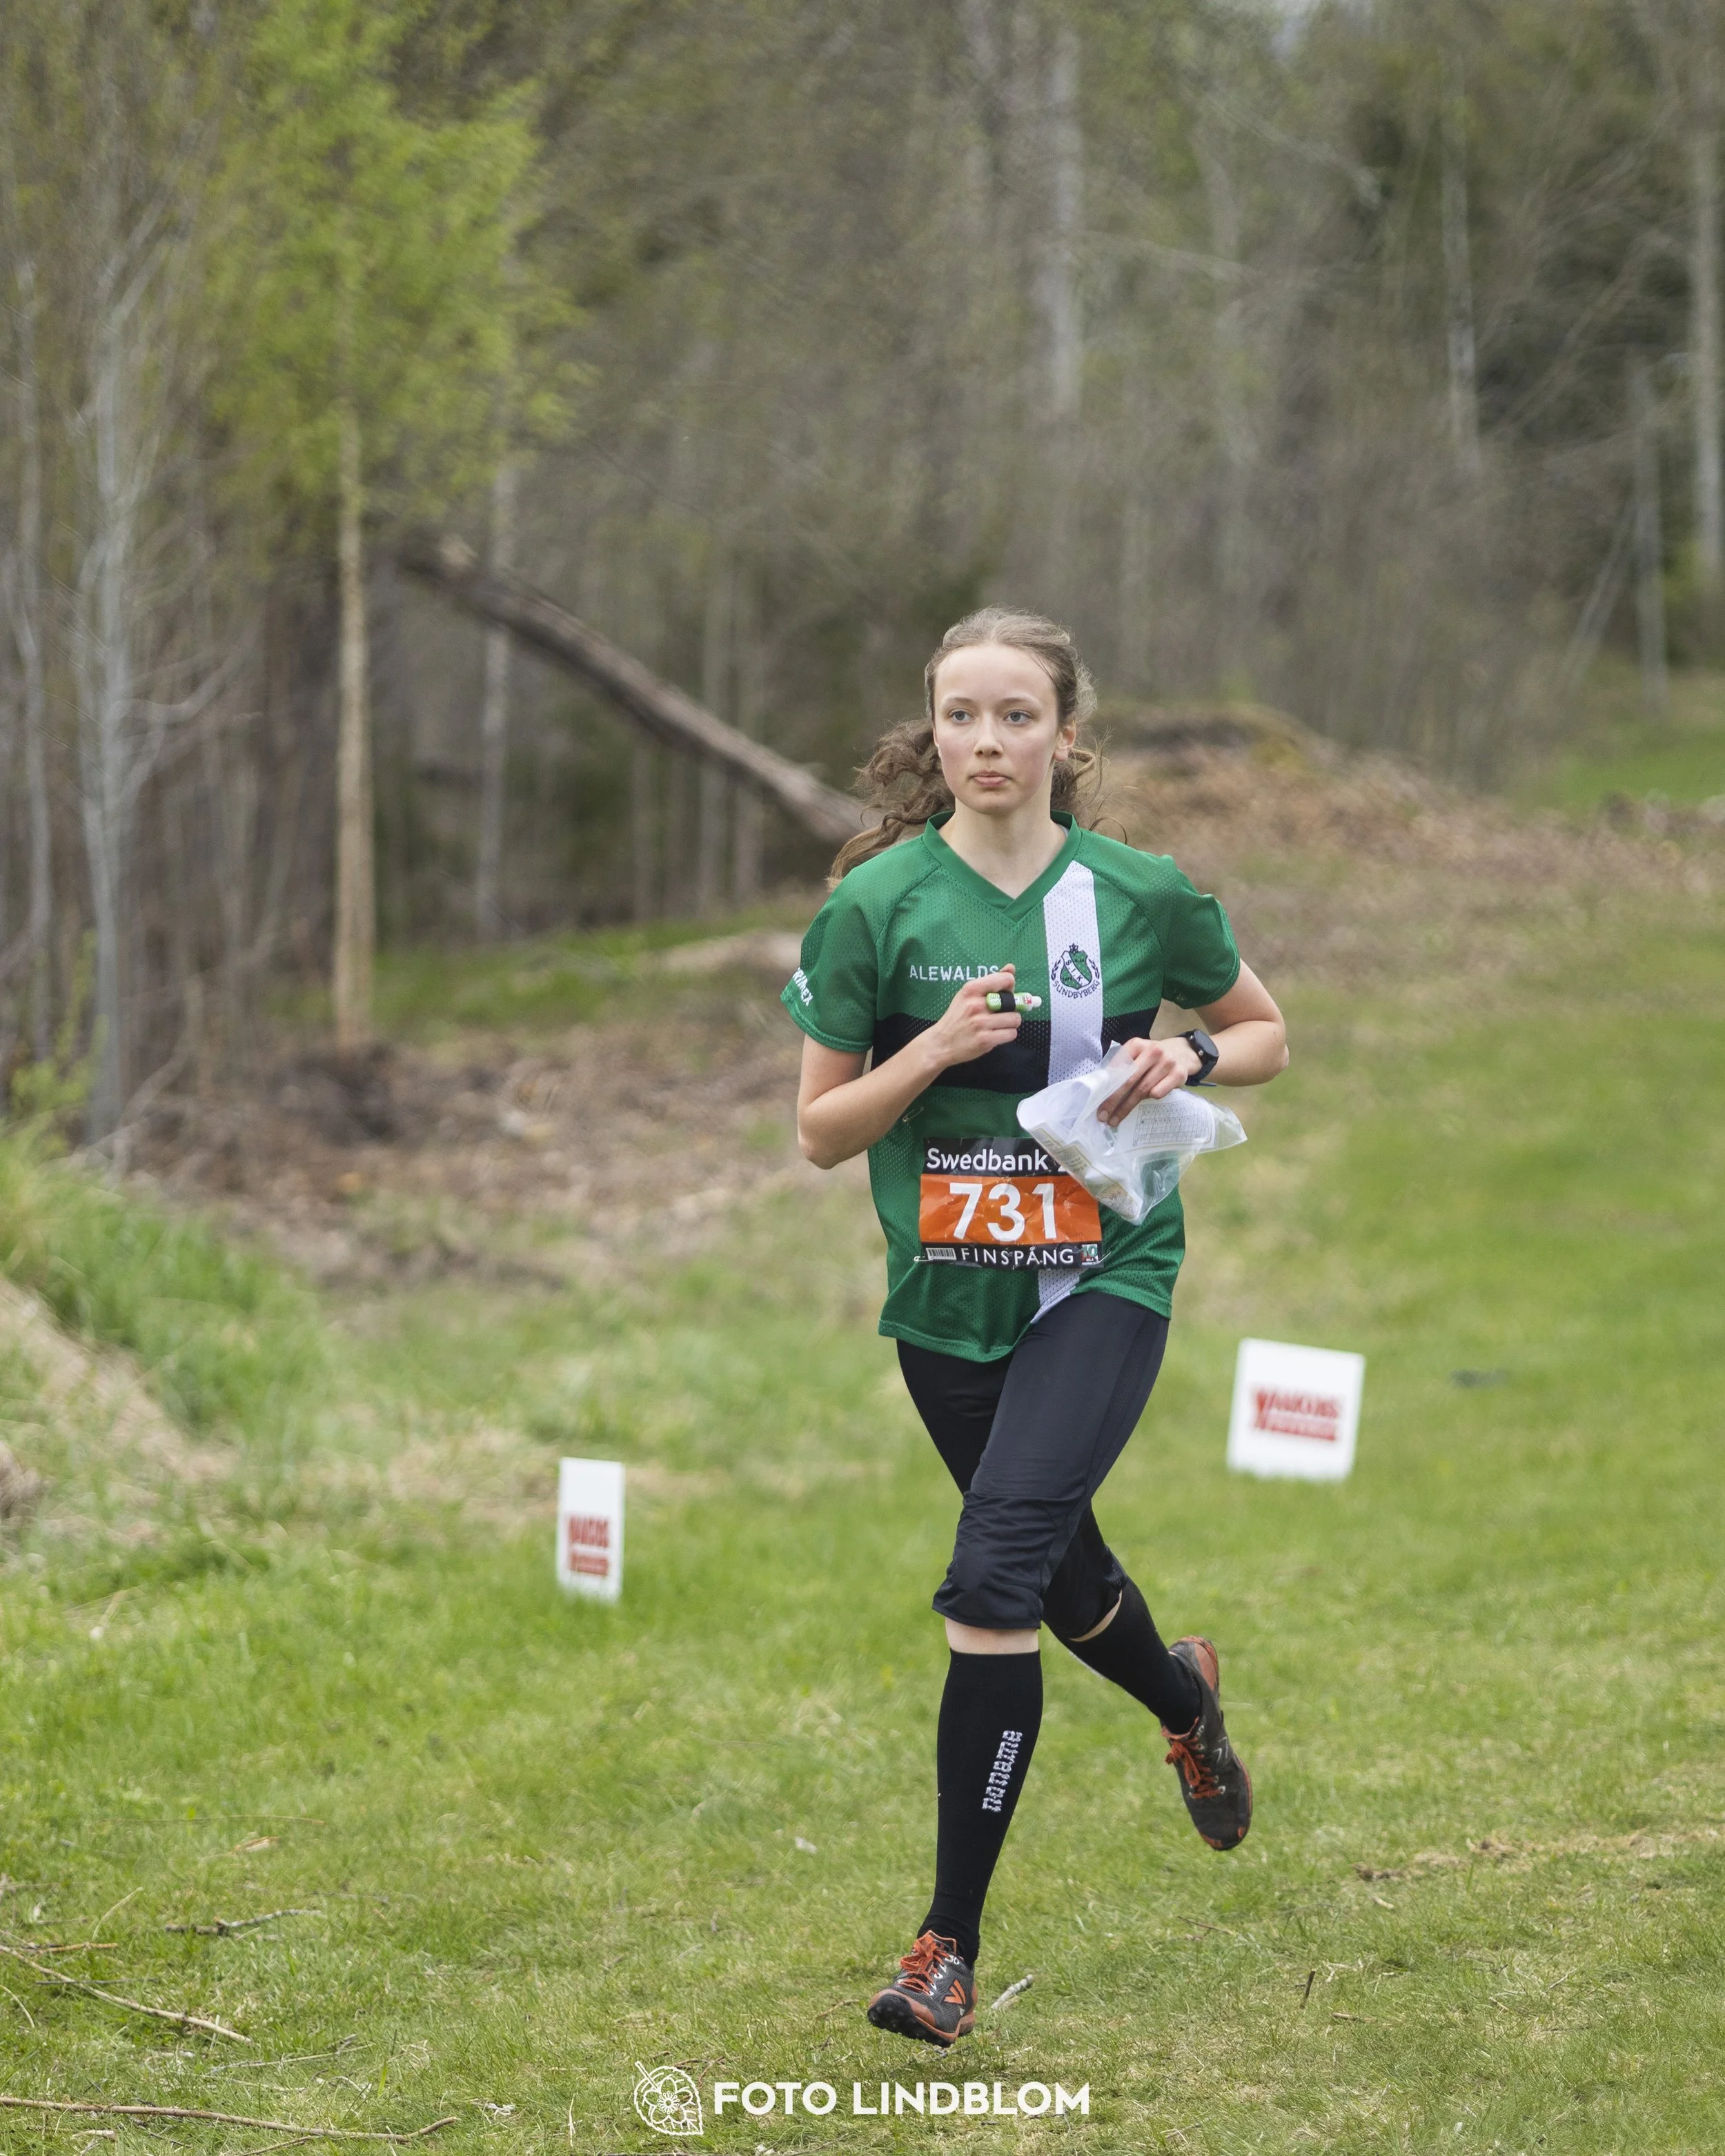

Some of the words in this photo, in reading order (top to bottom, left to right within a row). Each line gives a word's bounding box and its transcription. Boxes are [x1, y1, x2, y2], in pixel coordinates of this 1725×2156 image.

[1052, 980, 1100, 999] SUNDBYBERG
[926, 1147, 1049, 1171] Swedbank
[949, 1182, 1057, 1242] 731
[961, 1246, 1074, 1265] FINSPÅNG
[982, 1730, 1023, 1812] noname
